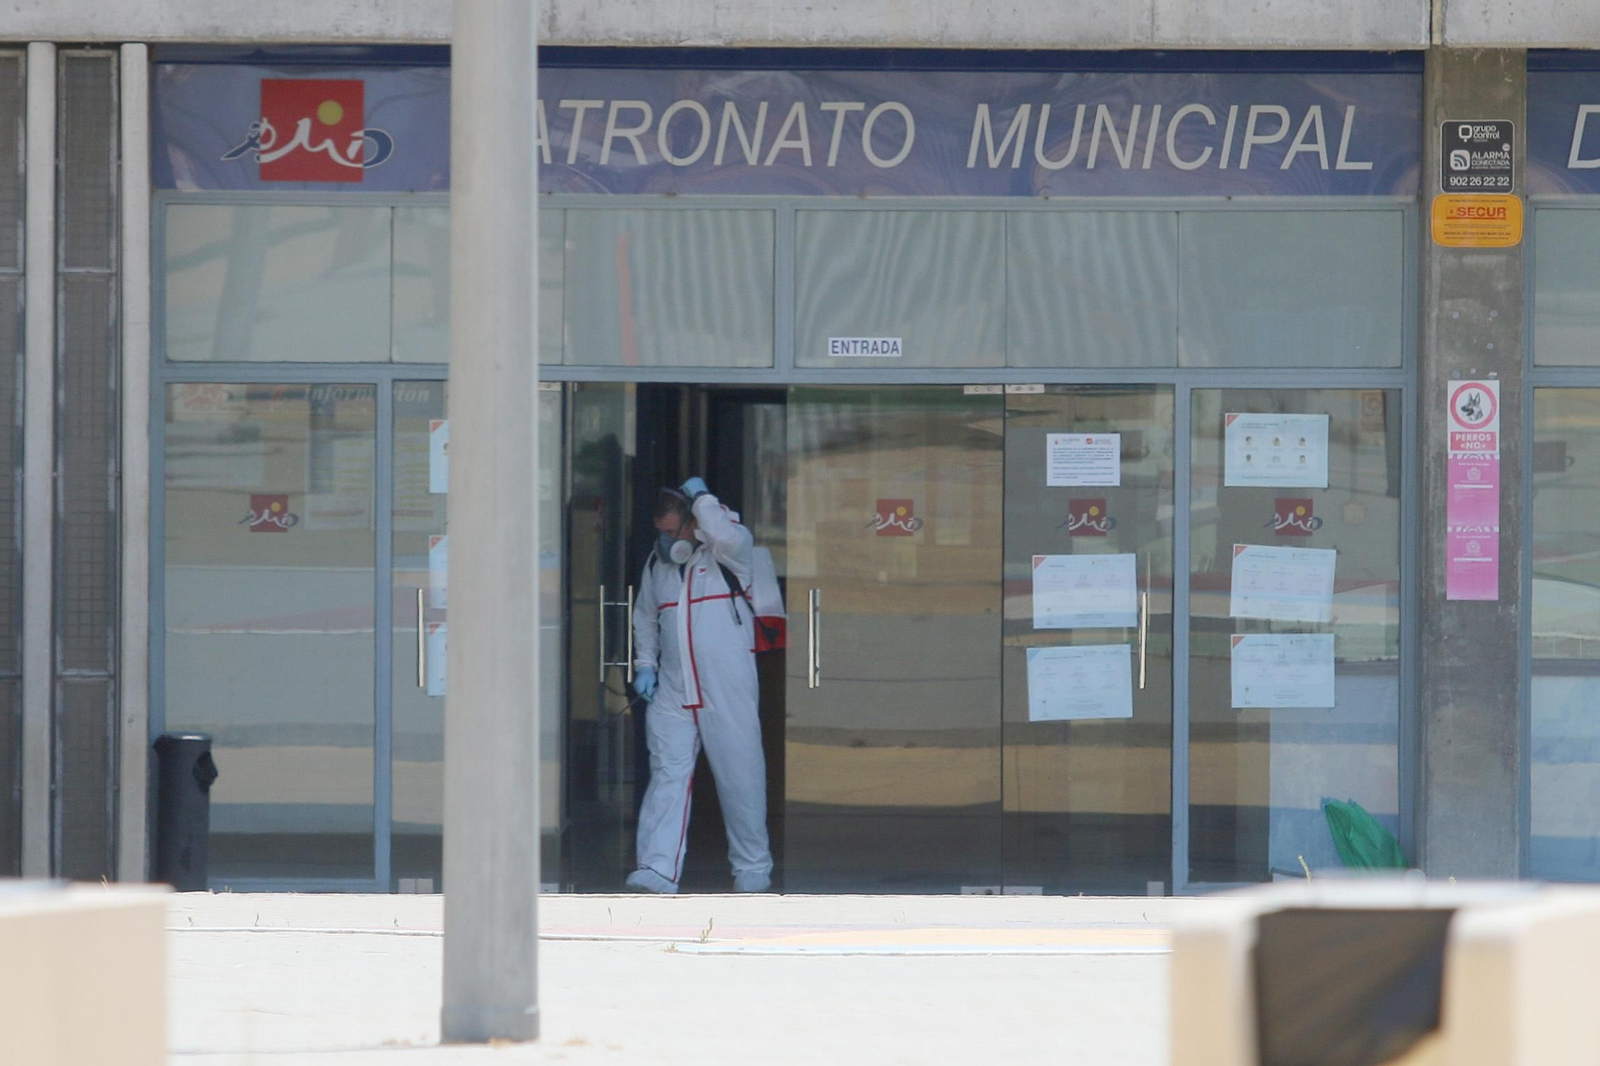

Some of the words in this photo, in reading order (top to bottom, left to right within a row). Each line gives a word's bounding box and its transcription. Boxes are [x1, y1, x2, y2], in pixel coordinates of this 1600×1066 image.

[1473, 125, 1497, 133] grupo
[537, 99, 915, 168] TRONATO
[966, 103, 1374, 170] MUNICIPAL
[1473, 130, 1500, 139] control
[1471, 151, 1510, 160] ALARMA
[1450, 176, 1468, 186] 902
[1469, 176, 1482, 186] 26
[1483, 176, 1495, 186] 22
[1497, 176, 1510, 186] 22
[1457, 206, 1507, 217] SECUR
[831, 340, 900, 355] ENTRADA
[1455, 433, 1492, 442] PERROS
